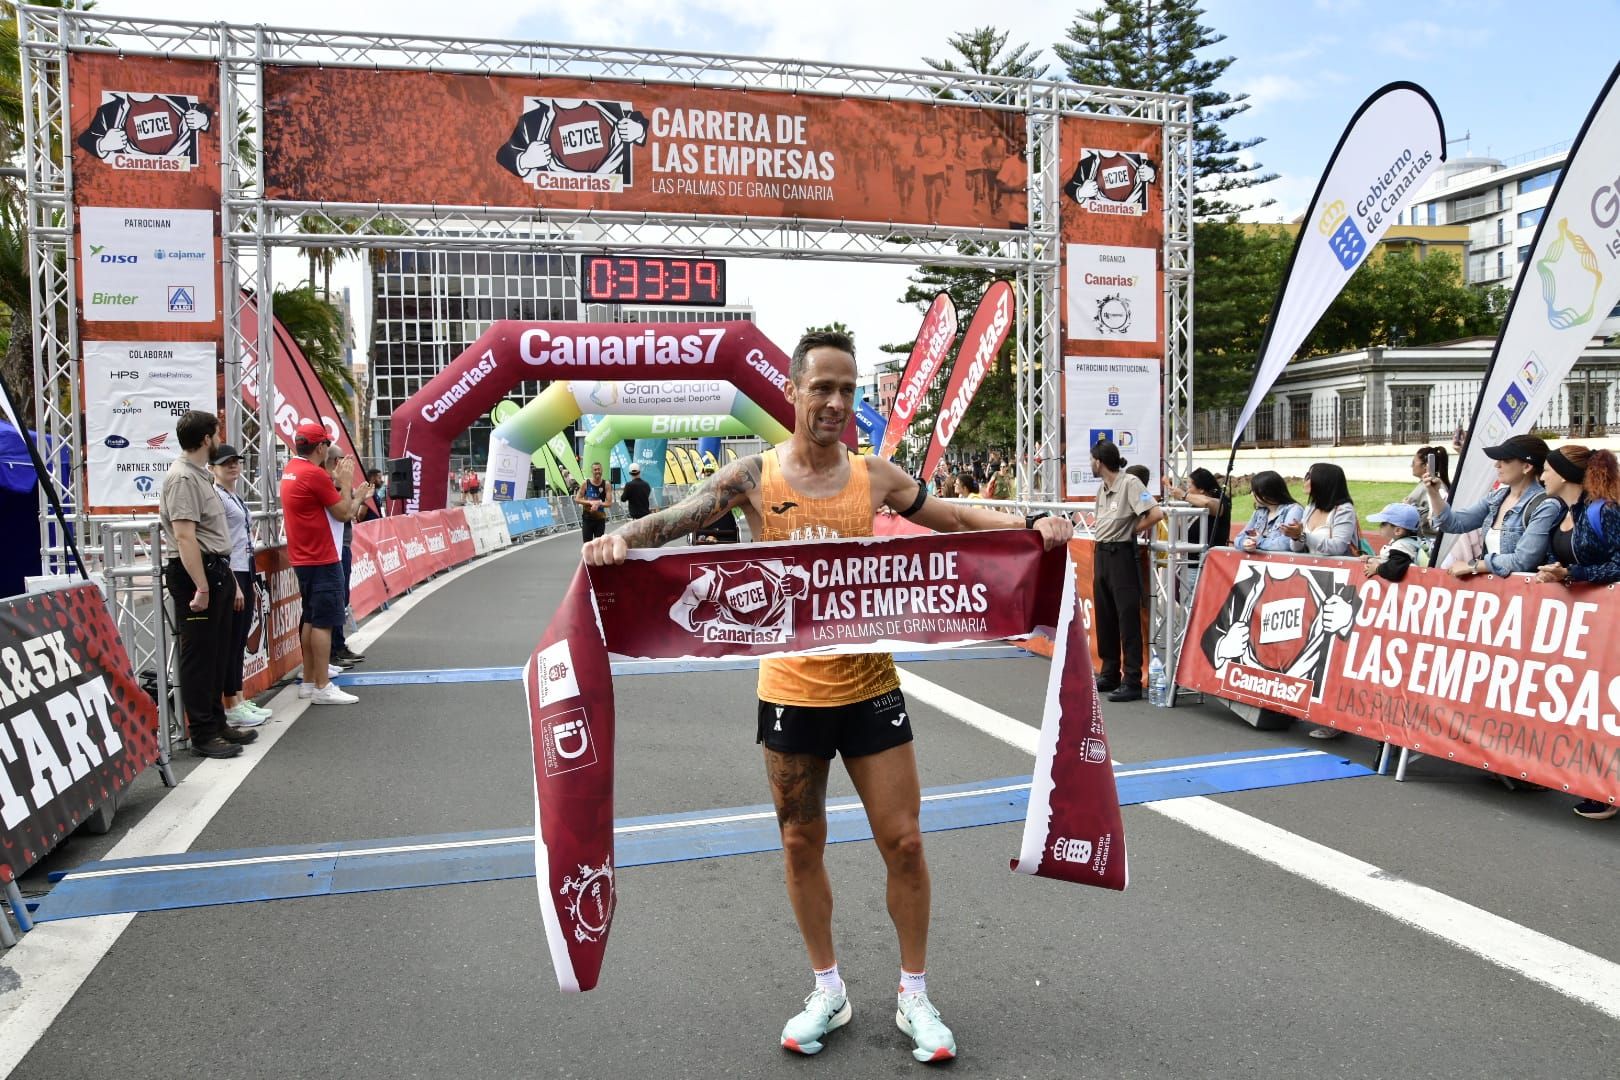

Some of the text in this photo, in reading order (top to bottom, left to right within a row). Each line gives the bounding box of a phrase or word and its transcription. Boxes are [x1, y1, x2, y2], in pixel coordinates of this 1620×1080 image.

[136, 116, 171, 135] #C7CE
[562, 127, 601, 147] #C7CE
[652, 107, 807, 145] CARRERA DE
[114, 155, 188, 171] Canarias7
[651, 142, 836, 182] LAS EMPRESAS
[536, 172, 620, 192] Canarias7
[651, 178, 834, 201] LAS PALMAS DE GRAN CANARIA
[1104, 169, 1129, 186] #C7CE
[1356, 148, 1413, 219] Gobierno
[1366, 150, 1433, 235] de Canarias
[1089, 200, 1141, 216] Canarias7
[124, 218, 171, 229] PATROCINAN
[168, 249, 206, 261] cajamar
[1099, 254, 1126, 264] ORGANIZA
[590, 259, 718, 300] 0:33:39
[1084, 272, 1139, 288] Canarias7
[91, 292, 139, 305] Binter
[129, 350, 173, 360] COLABORAN
[519, 327, 727, 366] Canarias7
[893, 302, 951, 420] Canarias7
[935, 288, 1009, 448] Canarias7
[1076, 363, 1150, 374] PATROCINIO INSTITUCIONAL
[110, 370, 139, 380] HPS
[420, 349, 499, 423] Canarias7
[153, 400, 191, 410] POWER
[622, 396, 637, 404] Isla
[639, 396, 672, 406] Europea
[688, 393, 721, 403] Deporte
[651, 414, 727, 434] Binter
[116, 462, 151, 473] PARTNER
[812, 551, 960, 588] CARRERA DE
[729, 583, 768, 609] #C7CE
[812, 582, 989, 622] LAS EMPRESAS
[811, 616, 988, 641] LAS PALMAS DE GRAN CANARIA
[1261, 606, 1301, 634] #C7CE
[1355, 579, 1599, 660] CARRERA DE
[705, 623, 783, 644] Canarias7
[1228, 665, 1305, 703] Canarias7
[1342, 631, 1620, 738] LAS EMPRESAS
[1336, 685, 1368, 715] LAS
[1371, 692, 1446, 738] PALMAS
[1447, 711, 1477, 744] DE
[1478, 717, 1546, 762] GRAN
[1092, 834, 1105, 872] Gobierno
[1098, 832, 1112, 876] de Canarias
